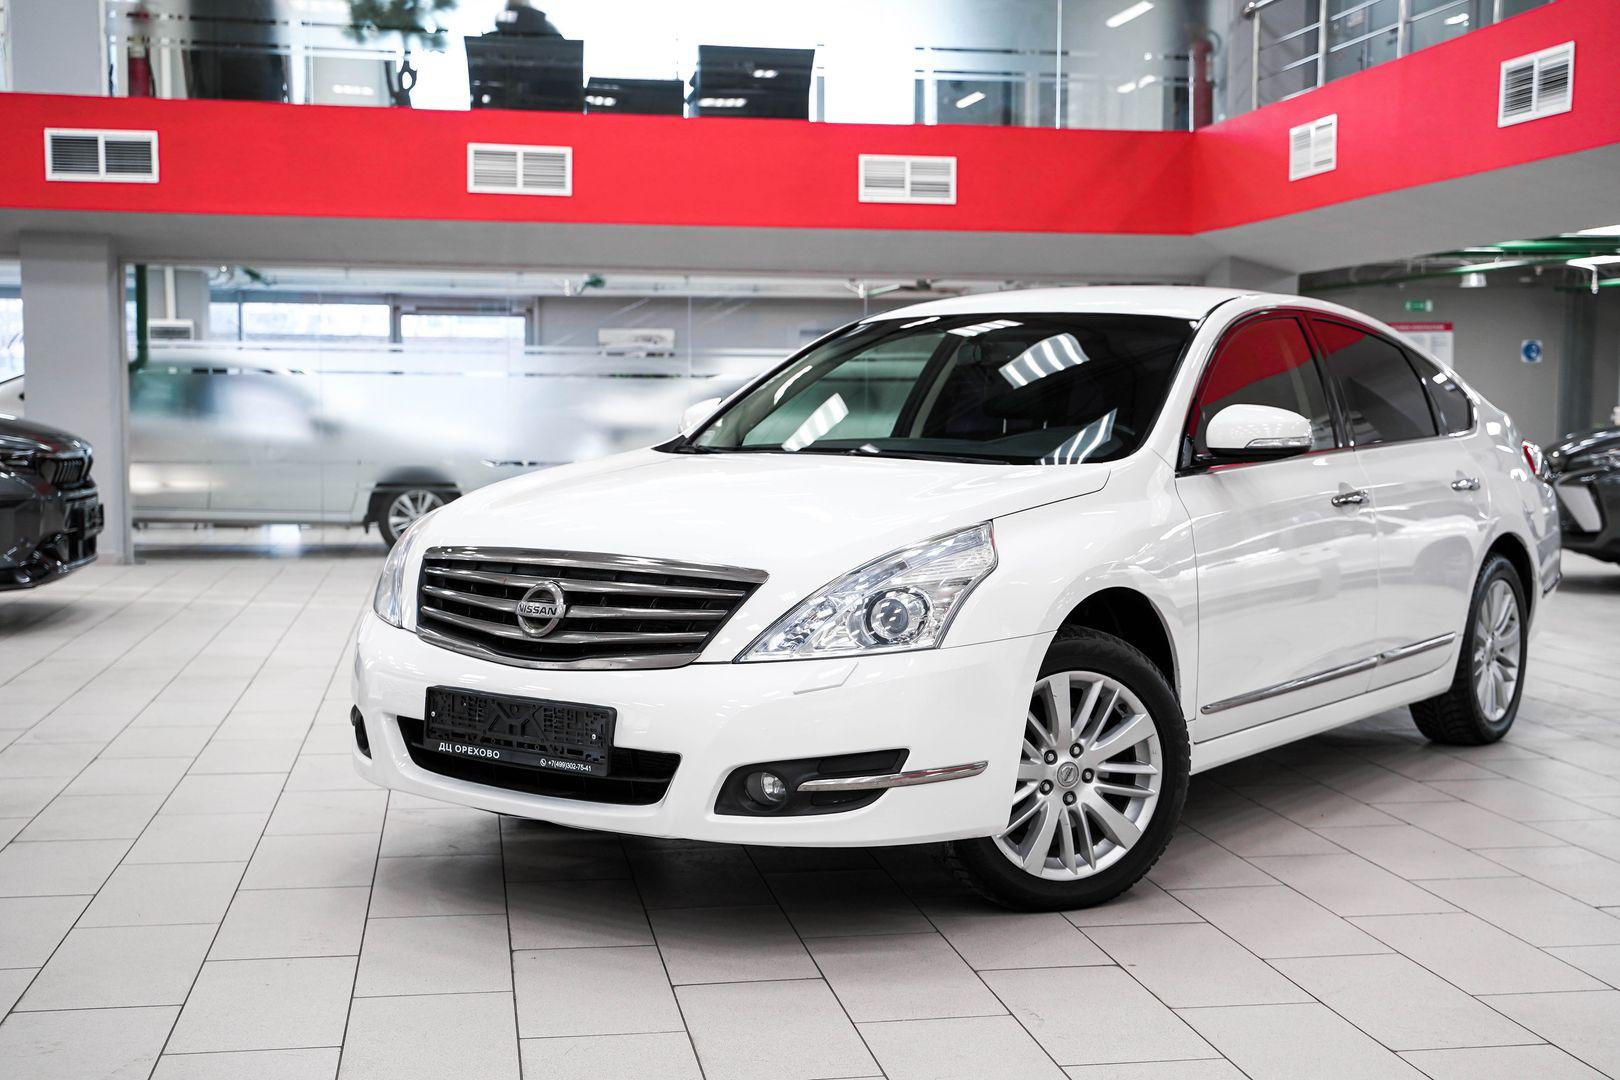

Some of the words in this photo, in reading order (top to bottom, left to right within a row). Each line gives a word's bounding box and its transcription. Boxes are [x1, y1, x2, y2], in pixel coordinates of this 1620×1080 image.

[519, 604, 557, 615] NISSAN
[438, 742, 452, 752] ДЦ
[454, 744, 500, 759] ОРЕХОВО
